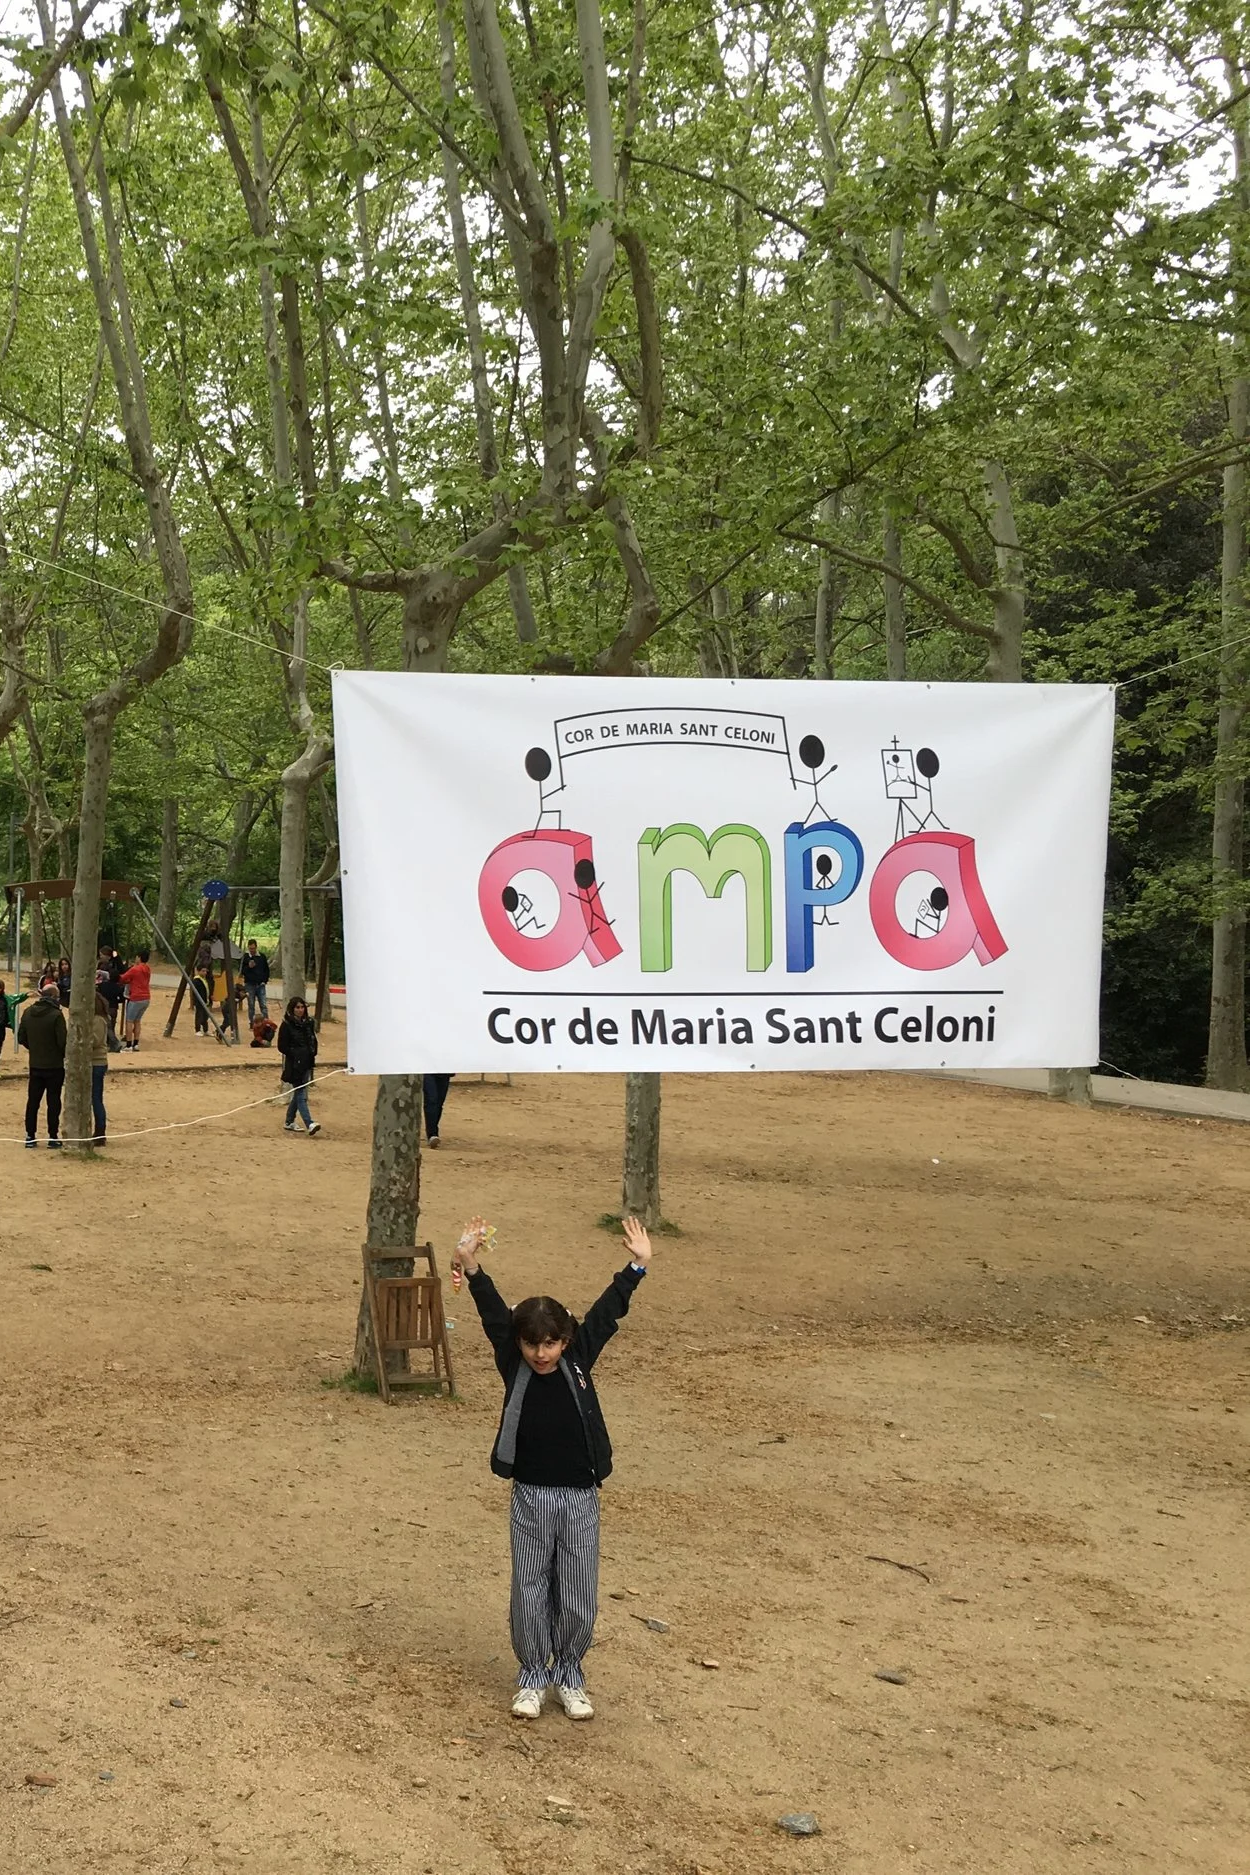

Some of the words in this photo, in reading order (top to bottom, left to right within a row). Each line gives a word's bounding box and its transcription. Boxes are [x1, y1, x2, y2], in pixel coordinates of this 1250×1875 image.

[564, 728, 595, 744] COR
[600, 724, 620, 739] DE
[626, 722, 673, 736] MARIA
[680, 722, 718, 737] SANT
[724, 726, 775, 745] CELONI
[478, 822, 1009, 973] ampa
[487, 1007, 556, 1045] Cor
[568, 1007, 619, 1046] de
[631, 1007, 754, 1045] Maria
[765, 1008, 862, 1044] Sant
[874, 1005, 996, 1044] Celoni
